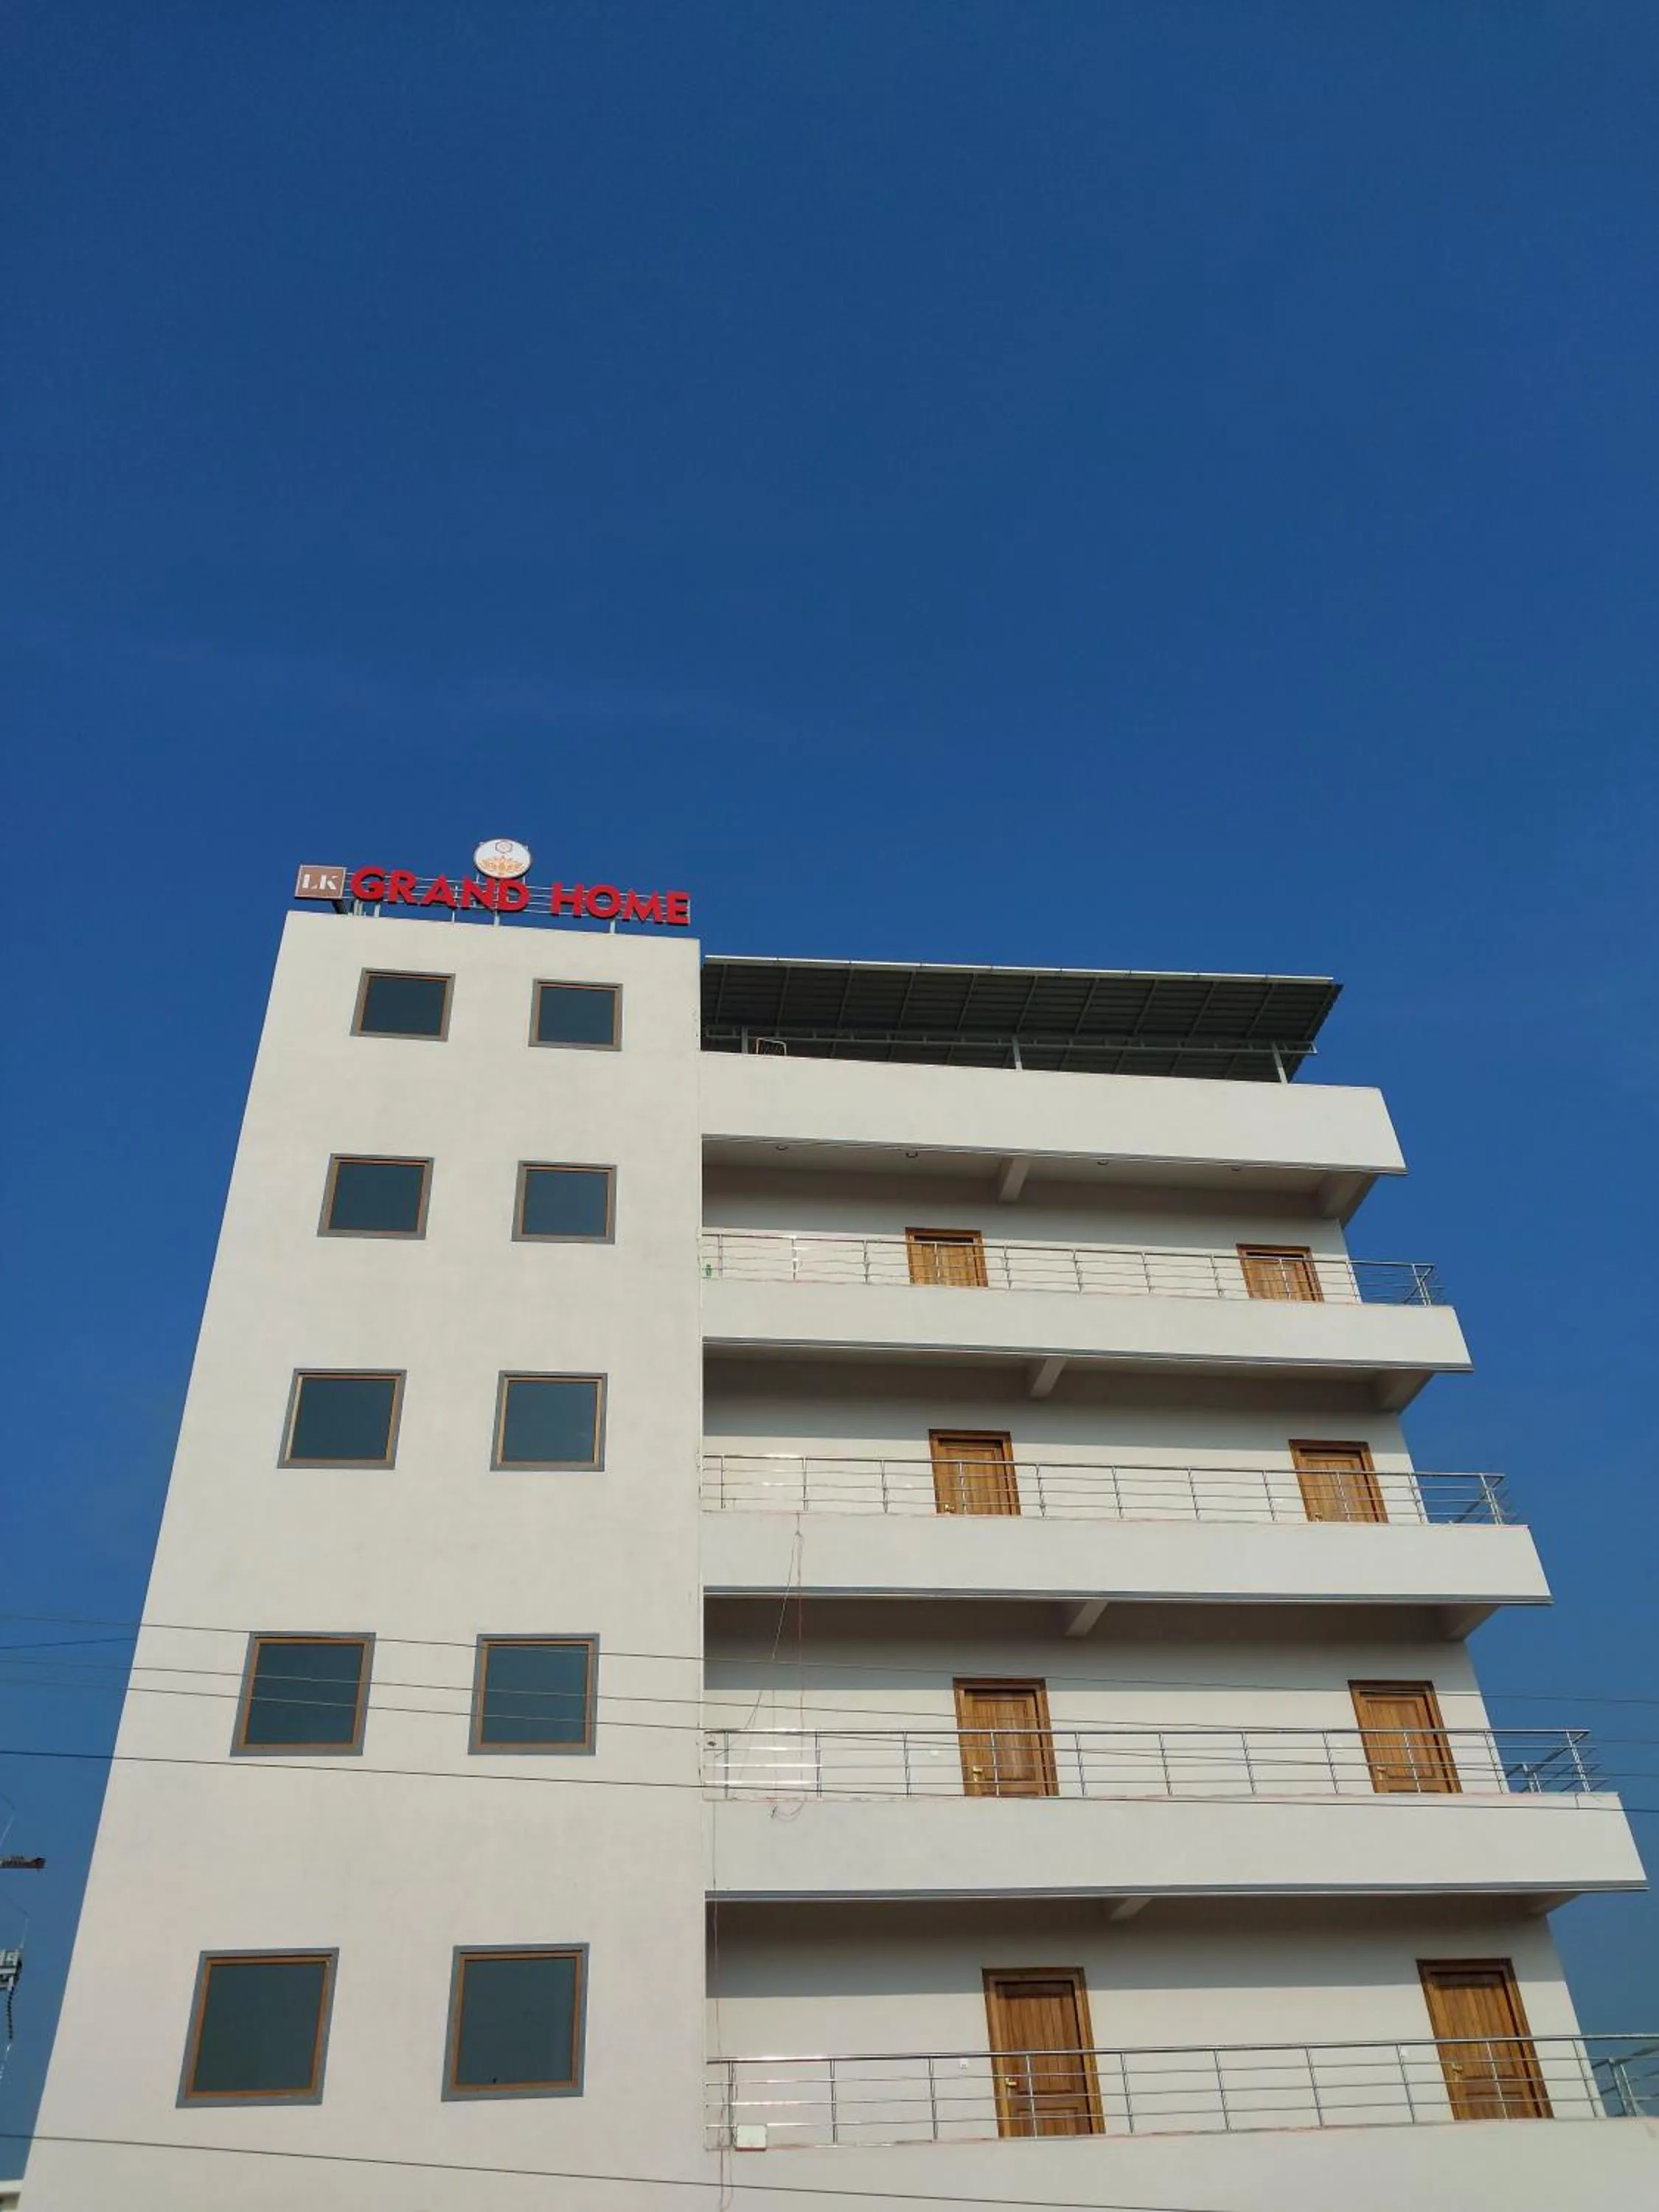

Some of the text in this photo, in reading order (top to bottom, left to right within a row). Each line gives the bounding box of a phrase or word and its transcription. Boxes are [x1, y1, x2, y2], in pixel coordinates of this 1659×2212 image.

[302, 865, 690, 926] LK GRAND HOME
